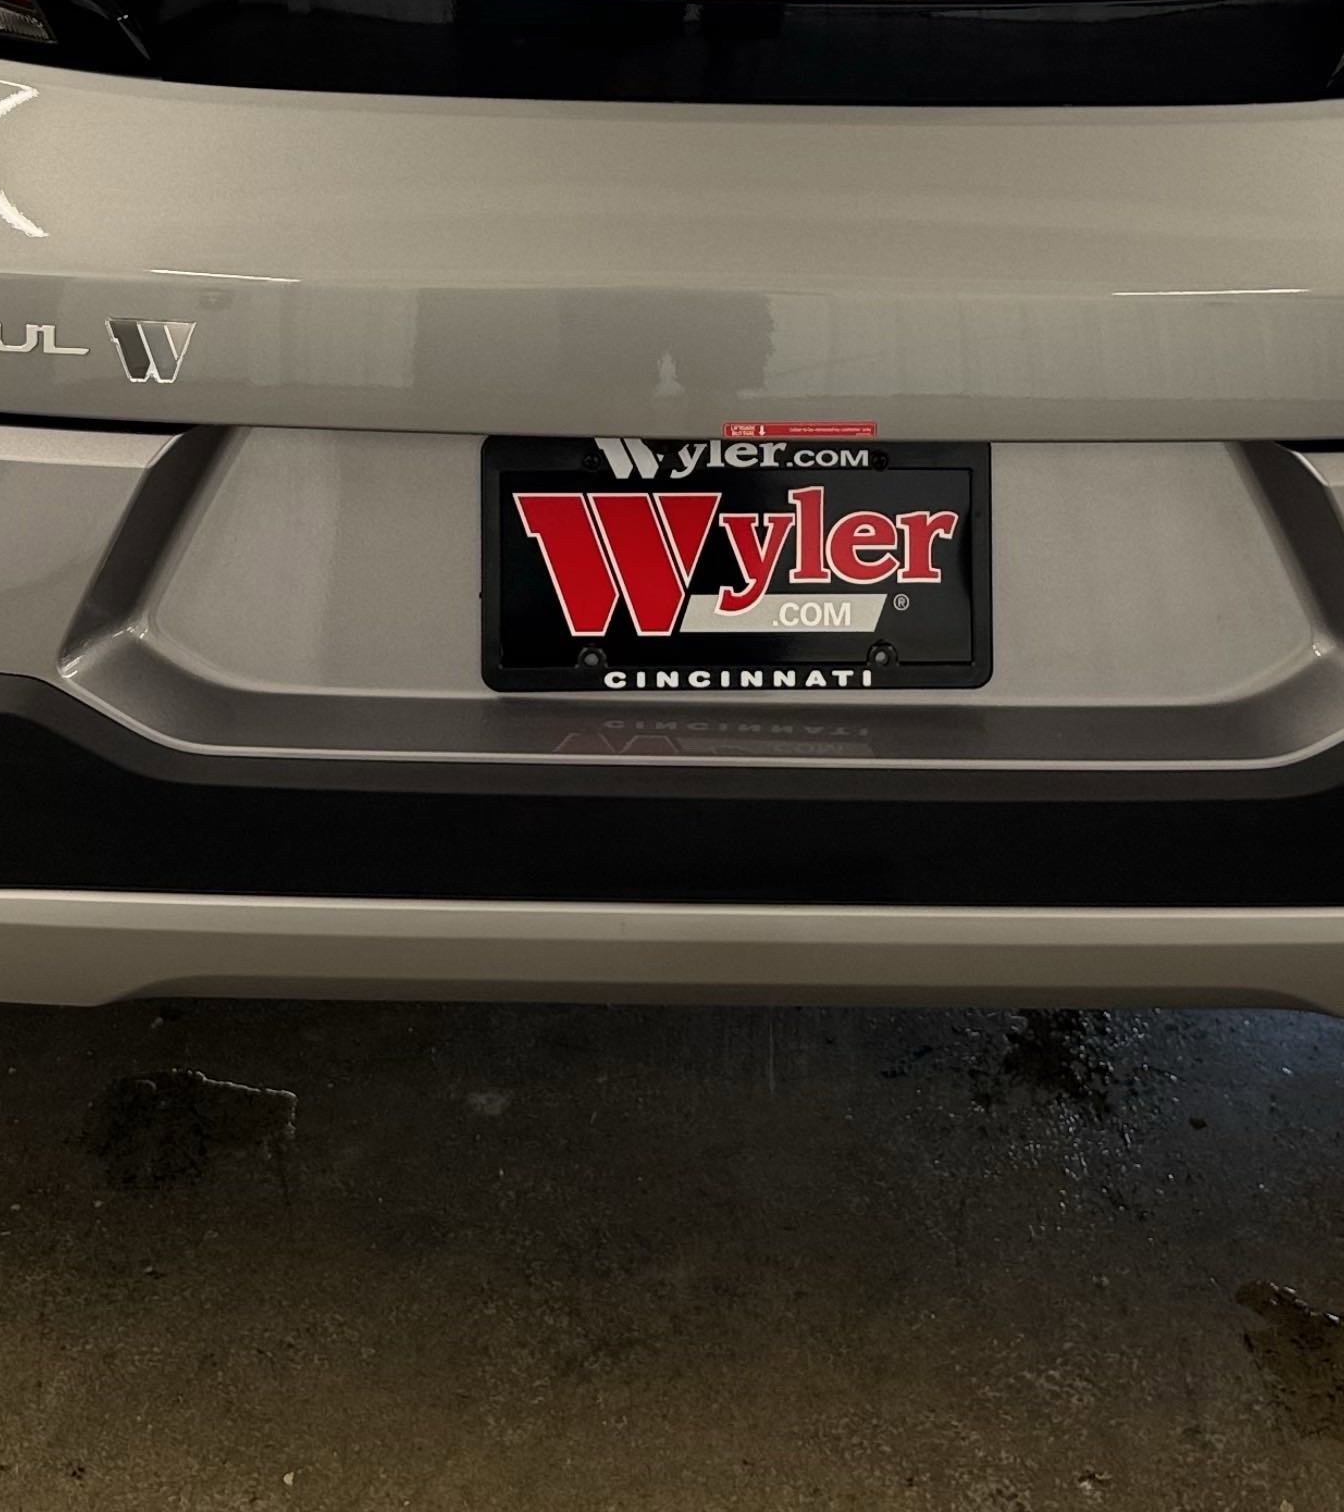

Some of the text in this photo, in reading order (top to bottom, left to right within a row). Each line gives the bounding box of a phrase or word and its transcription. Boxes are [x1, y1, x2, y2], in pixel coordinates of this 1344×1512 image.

[512, 486, 959, 636] Wyler
[772, 601, 852, 627] .COM
[604, 669, 873, 688] CINCINNATI
